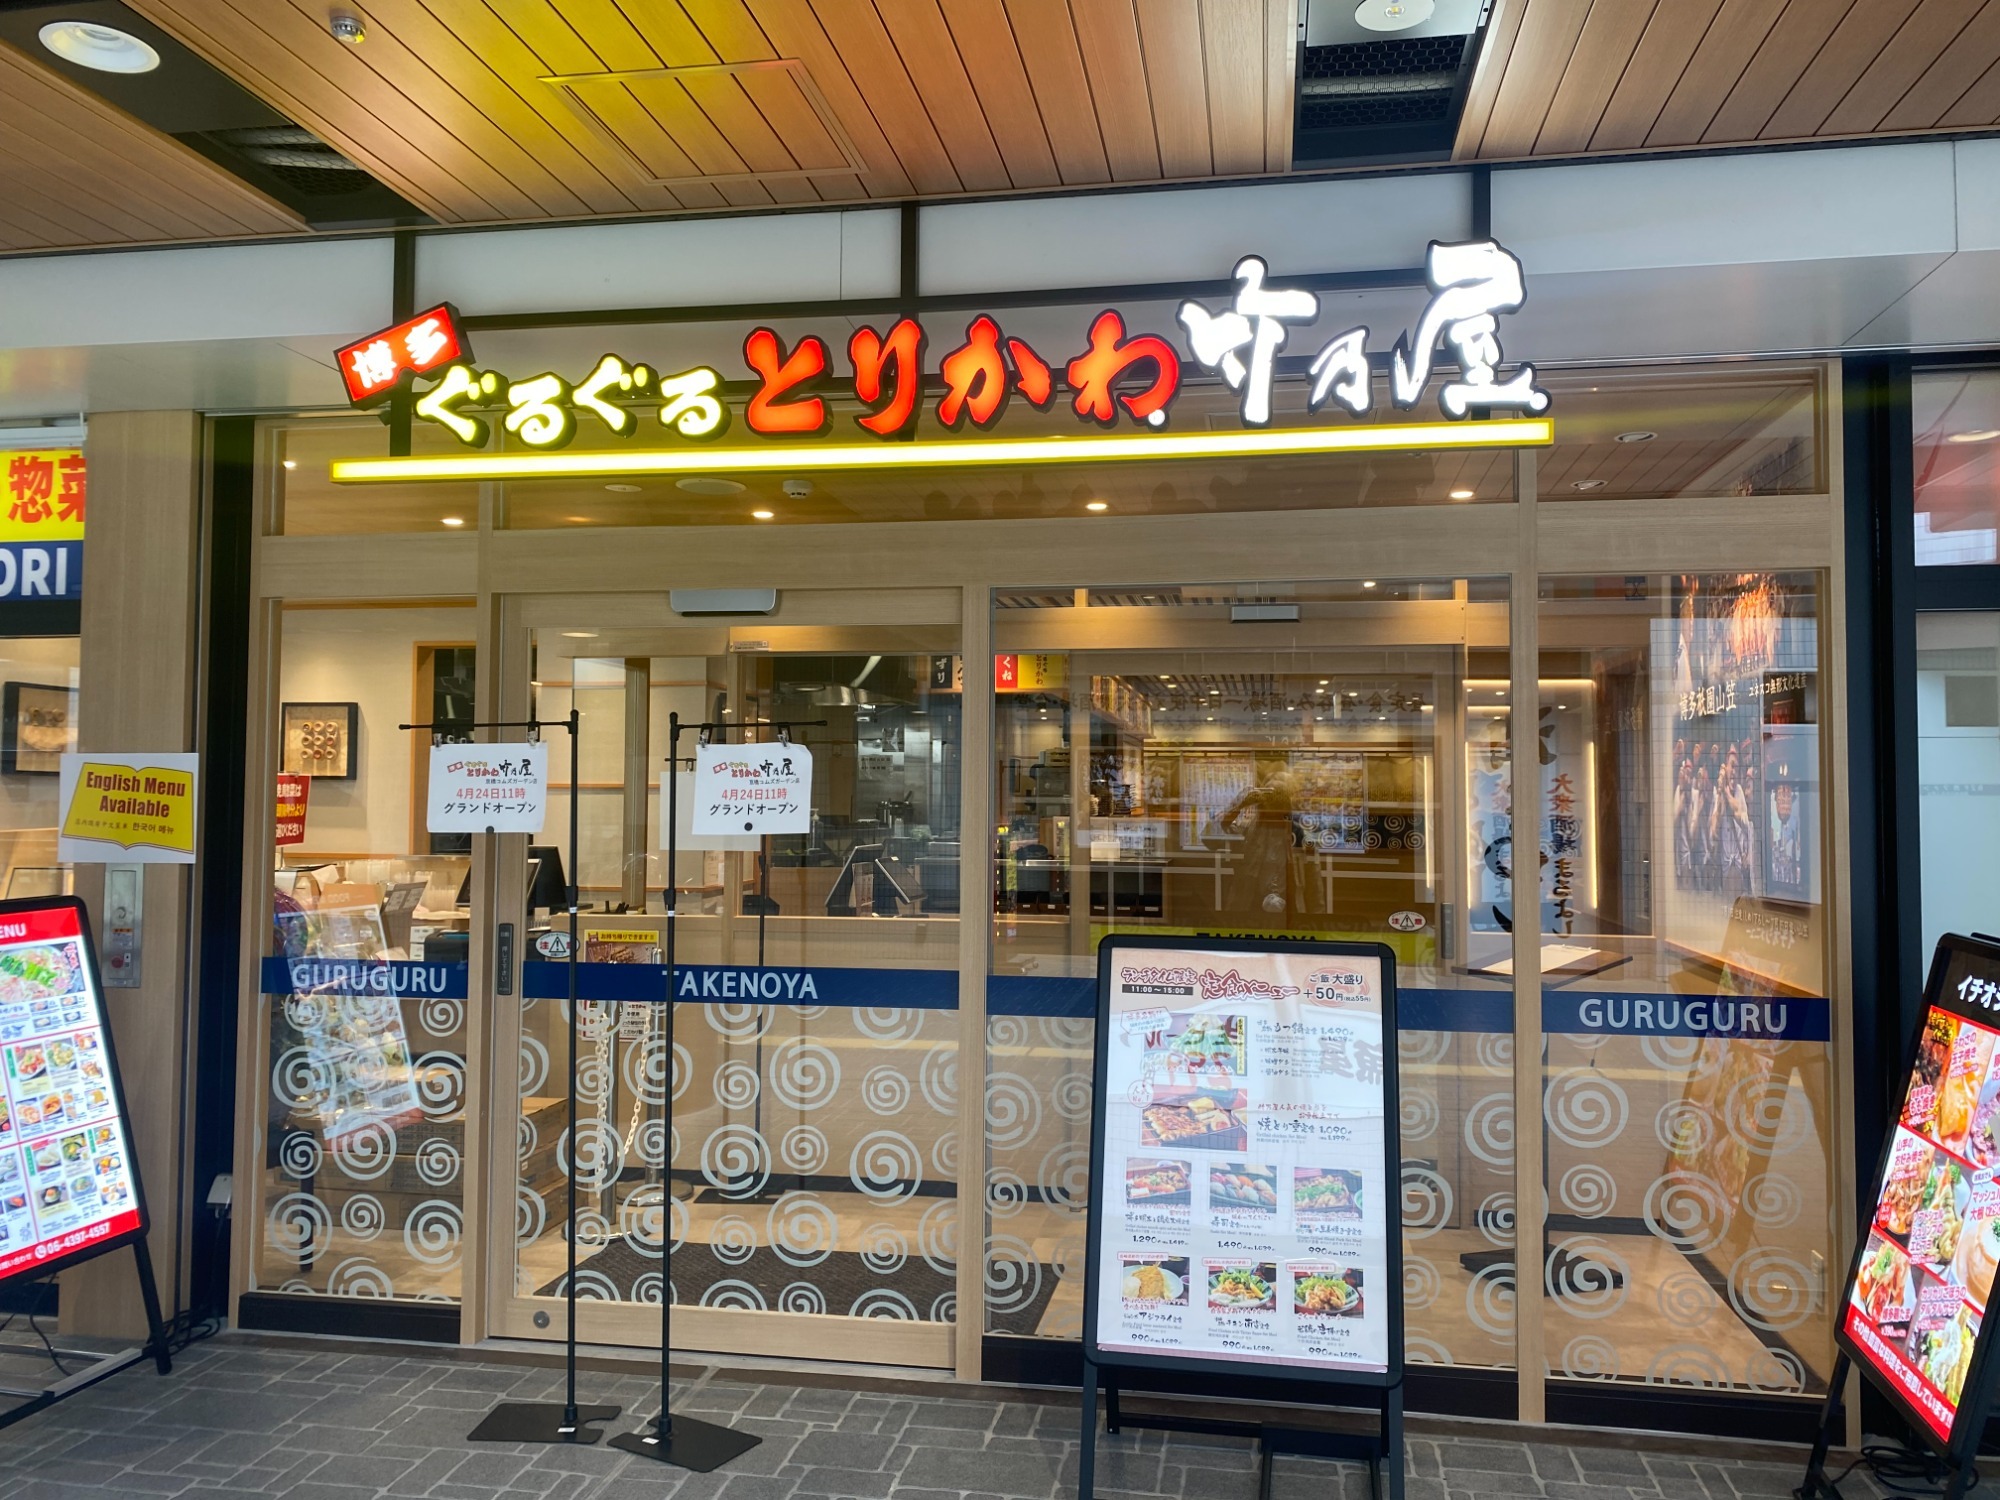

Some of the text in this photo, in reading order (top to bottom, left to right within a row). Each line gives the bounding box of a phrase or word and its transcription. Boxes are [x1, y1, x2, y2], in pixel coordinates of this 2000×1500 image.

[417, 240, 1550, 446] ぐるぐる とりかわ 竹乃屋
[350, 317, 448, 388] 博多
[86, 771, 185, 797] English Menu
[456, 788, 526, 799] 4月24日11時
[722, 788, 787, 800] 4月24日11時
[99, 795, 170, 818] Available
[444, 801, 536, 814] グランドオープン
[710, 803, 798, 815] グランドオープン
[133, 822, 156, 833] 한국어
[292, 964, 447, 993] GURUGURU
[1578, 998, 1787, 1034] GURUGURU
[1953, 1032, 1976, 1049] うわさの
[1951, 1049, 1977, 1065] 玉子焼き
[1921, 1286, 1966, 1300] カリカリごぼうの
[1920, 1301, 1962, 1316] タルタルサラダ
